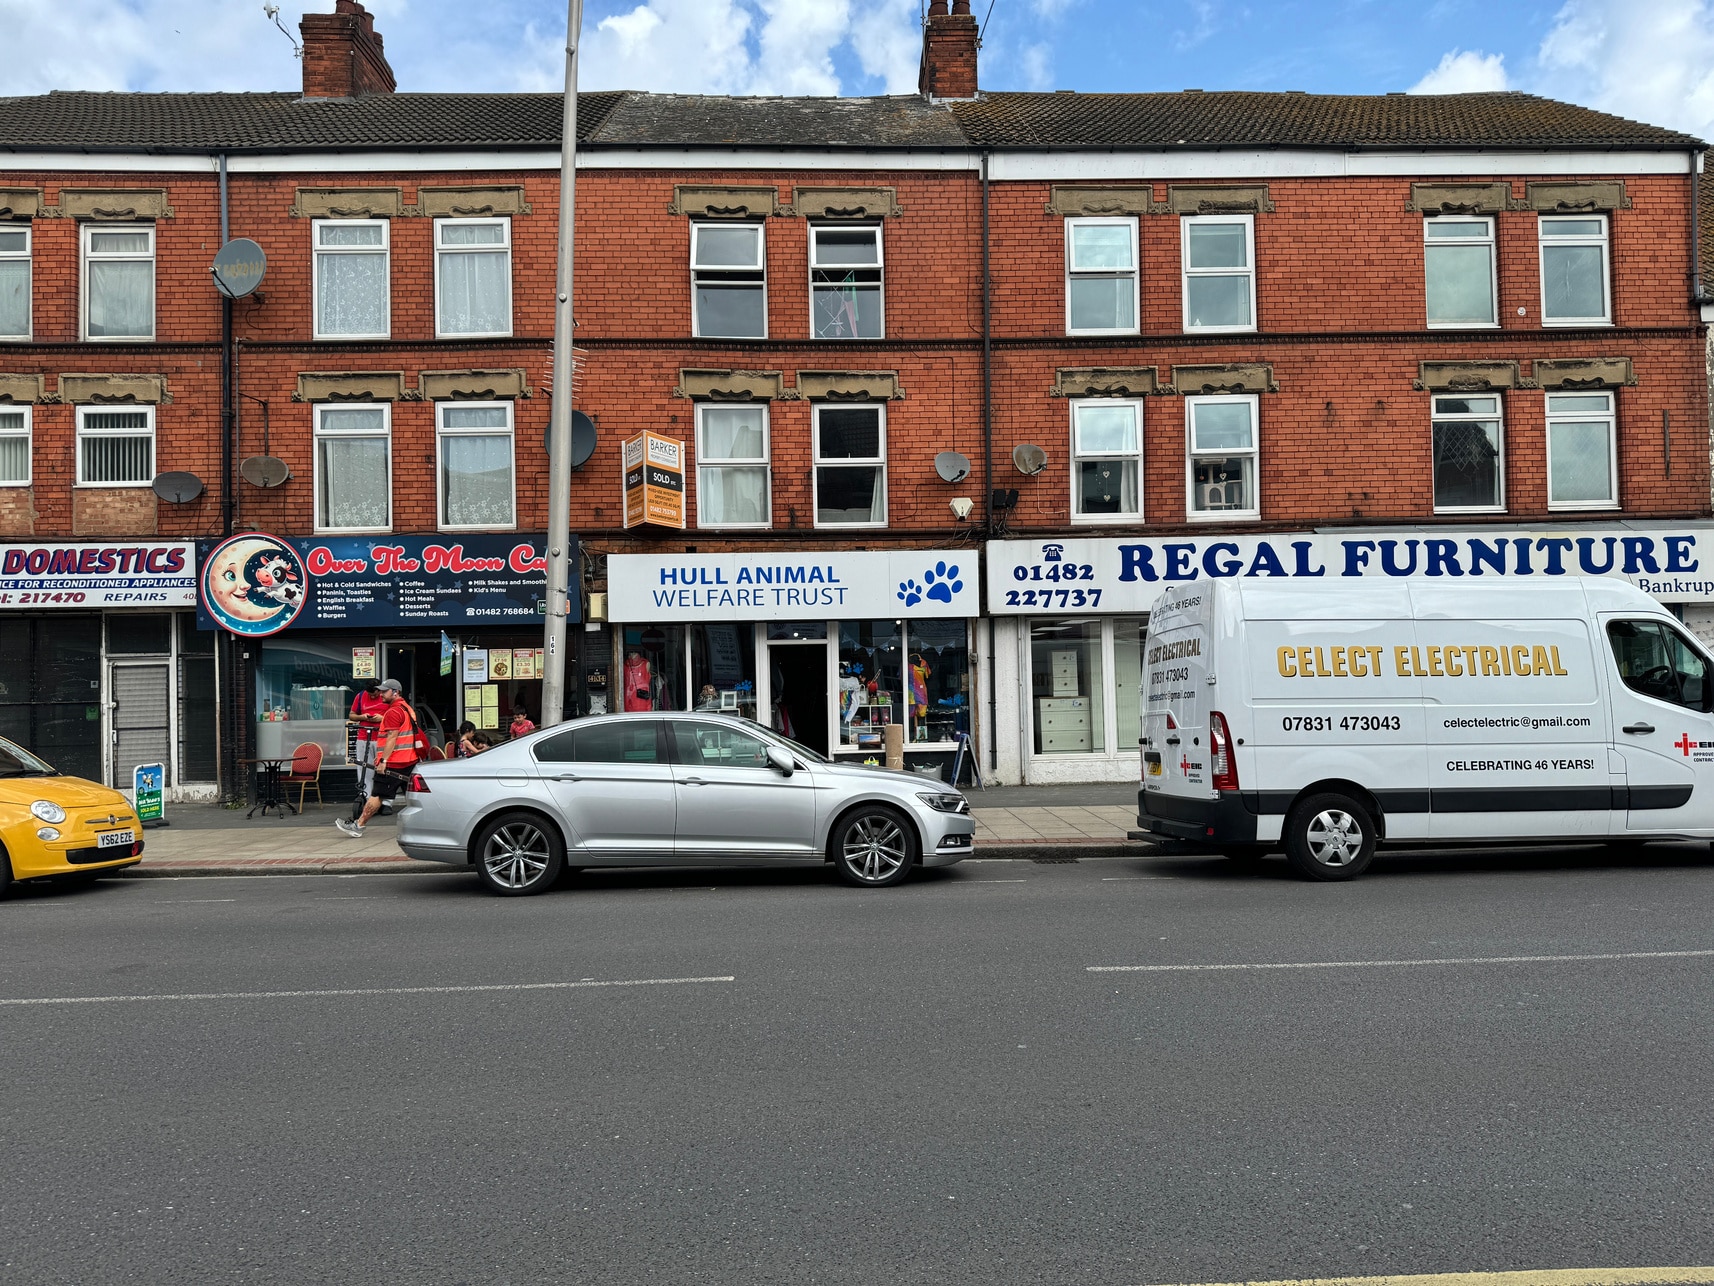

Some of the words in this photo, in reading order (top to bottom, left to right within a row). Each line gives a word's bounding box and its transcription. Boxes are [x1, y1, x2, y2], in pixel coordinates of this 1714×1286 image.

[650, 439, 677, 457] BARKER
[653, 472, 670, 484] SOLD
[2, 548, 186, 575] DOMESTICS
[306, 546, 368, 576] Over
[371, 545, 420, 576] The
[422, 544, 506, 574] Moon
[1118, 541, 1326, 582] REGAL
[1340, 535, 1699, 577] FURNITURE
[660, 567, 728, 586] HULL
[736, 566, 840, 584] ANIMAL
[1013, 563, 1094, 582] 01482
[18, 580, 40, 589] FOR
[42, 579, 129, 589] RECONDITIONED
[132, 578, 196, 588] APPLIANCES
[19, 592, 86, 604] 217470
[104, 592, 168, 602] REPAIRS
[652, 588, 765, 608] WELFARE
[771, 587, 848, 606] TRUST
[1005, 588, 1102, 608] 227737
[1182, 596, 1202, 610] YEARS!
[503, 607, 534, 616] 768684
[1162, 638, 1202, 662] ELECTRICAL
[1276, 645, 1384, 678] CELECT
[1394, 645, 1568, 677] ELECTRICAL
[1166, 667, 1189, 682] 473043
[1282, 716, 1332, 732] 07831
[1340, 716, 1401, 731] 473043
[1443, 716, 1591, 730] celectelectric@gmail.com
[1446, 760, 1532, 772] CELEBRATING
[1534, 760, 1549, 770] 46
[1550, 759, 1594, 770] YEARS!
[100, 834, 119, 846] YS62
[120, 832, 132, 844] EZE
